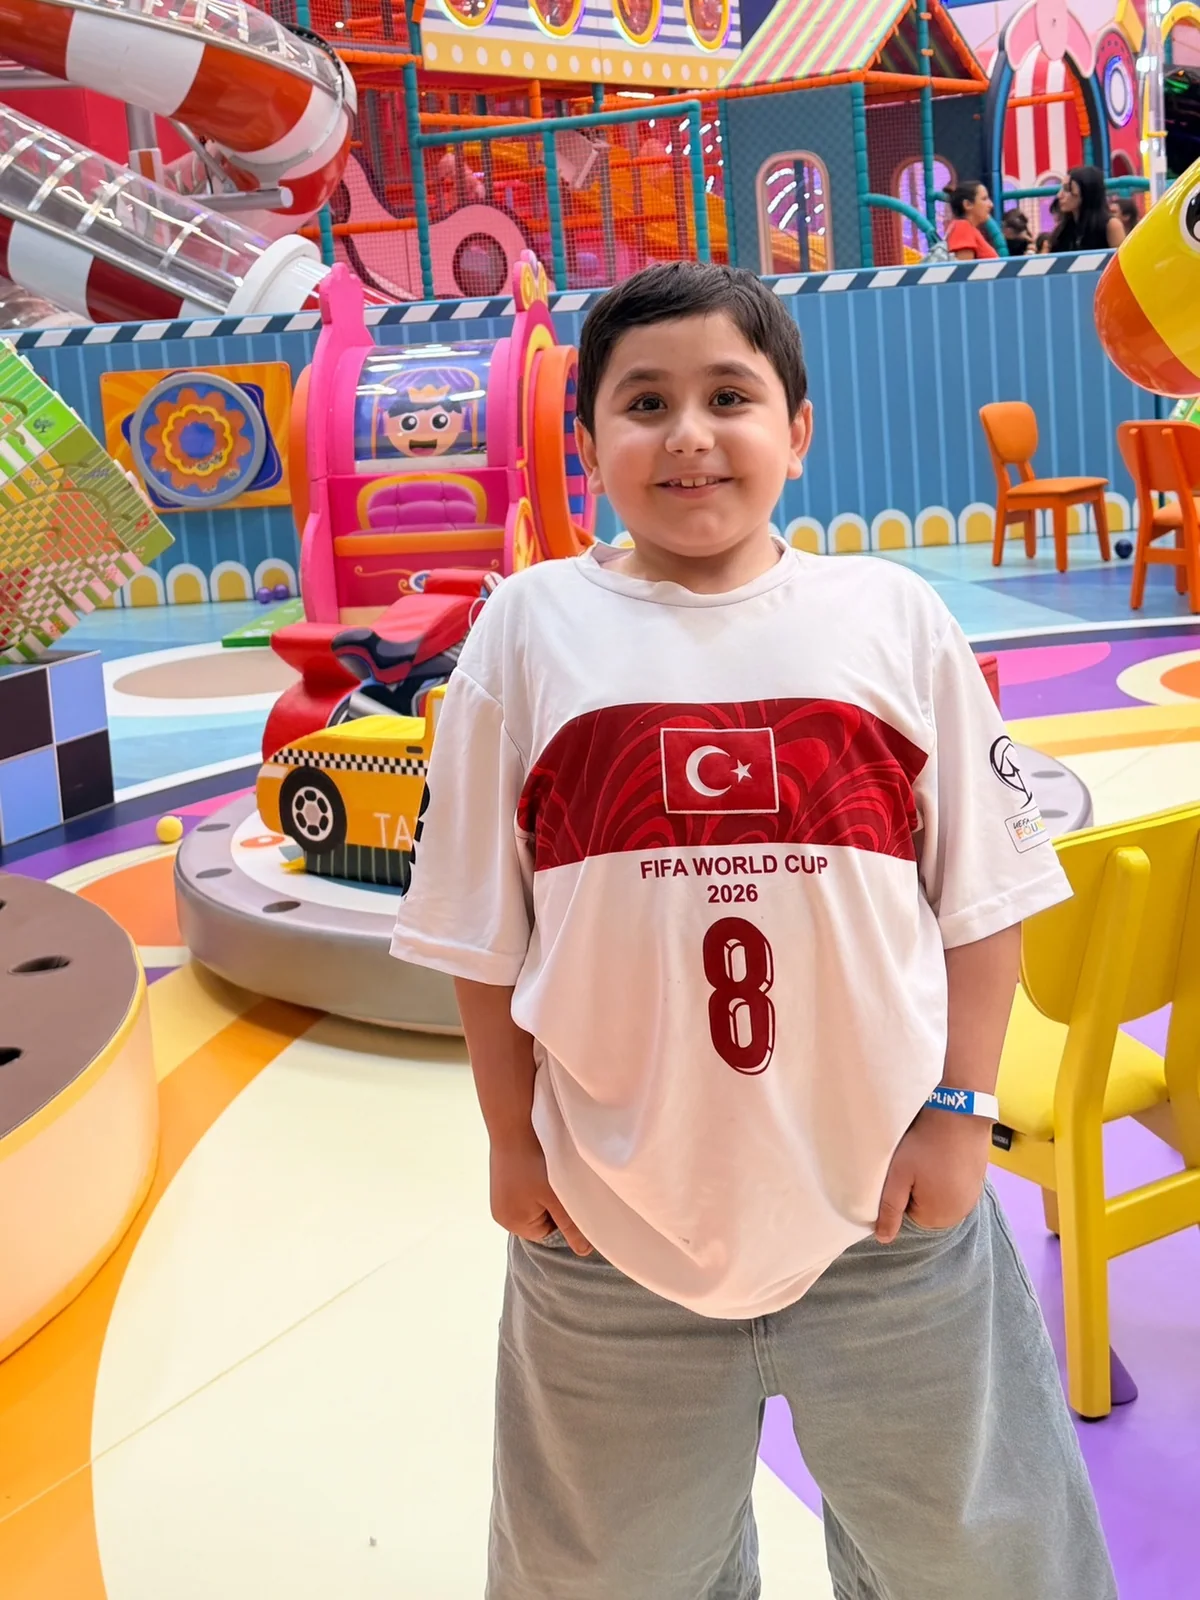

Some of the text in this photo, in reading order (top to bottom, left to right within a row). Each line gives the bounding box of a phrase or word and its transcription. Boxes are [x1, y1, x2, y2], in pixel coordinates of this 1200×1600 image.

[373, 812, 418, 851] TA
[640, 854, 828, 879] FIFA WORLD CUP
[707, 883, 759, 903] 2026
[702, 916, 776, 1076] 8
